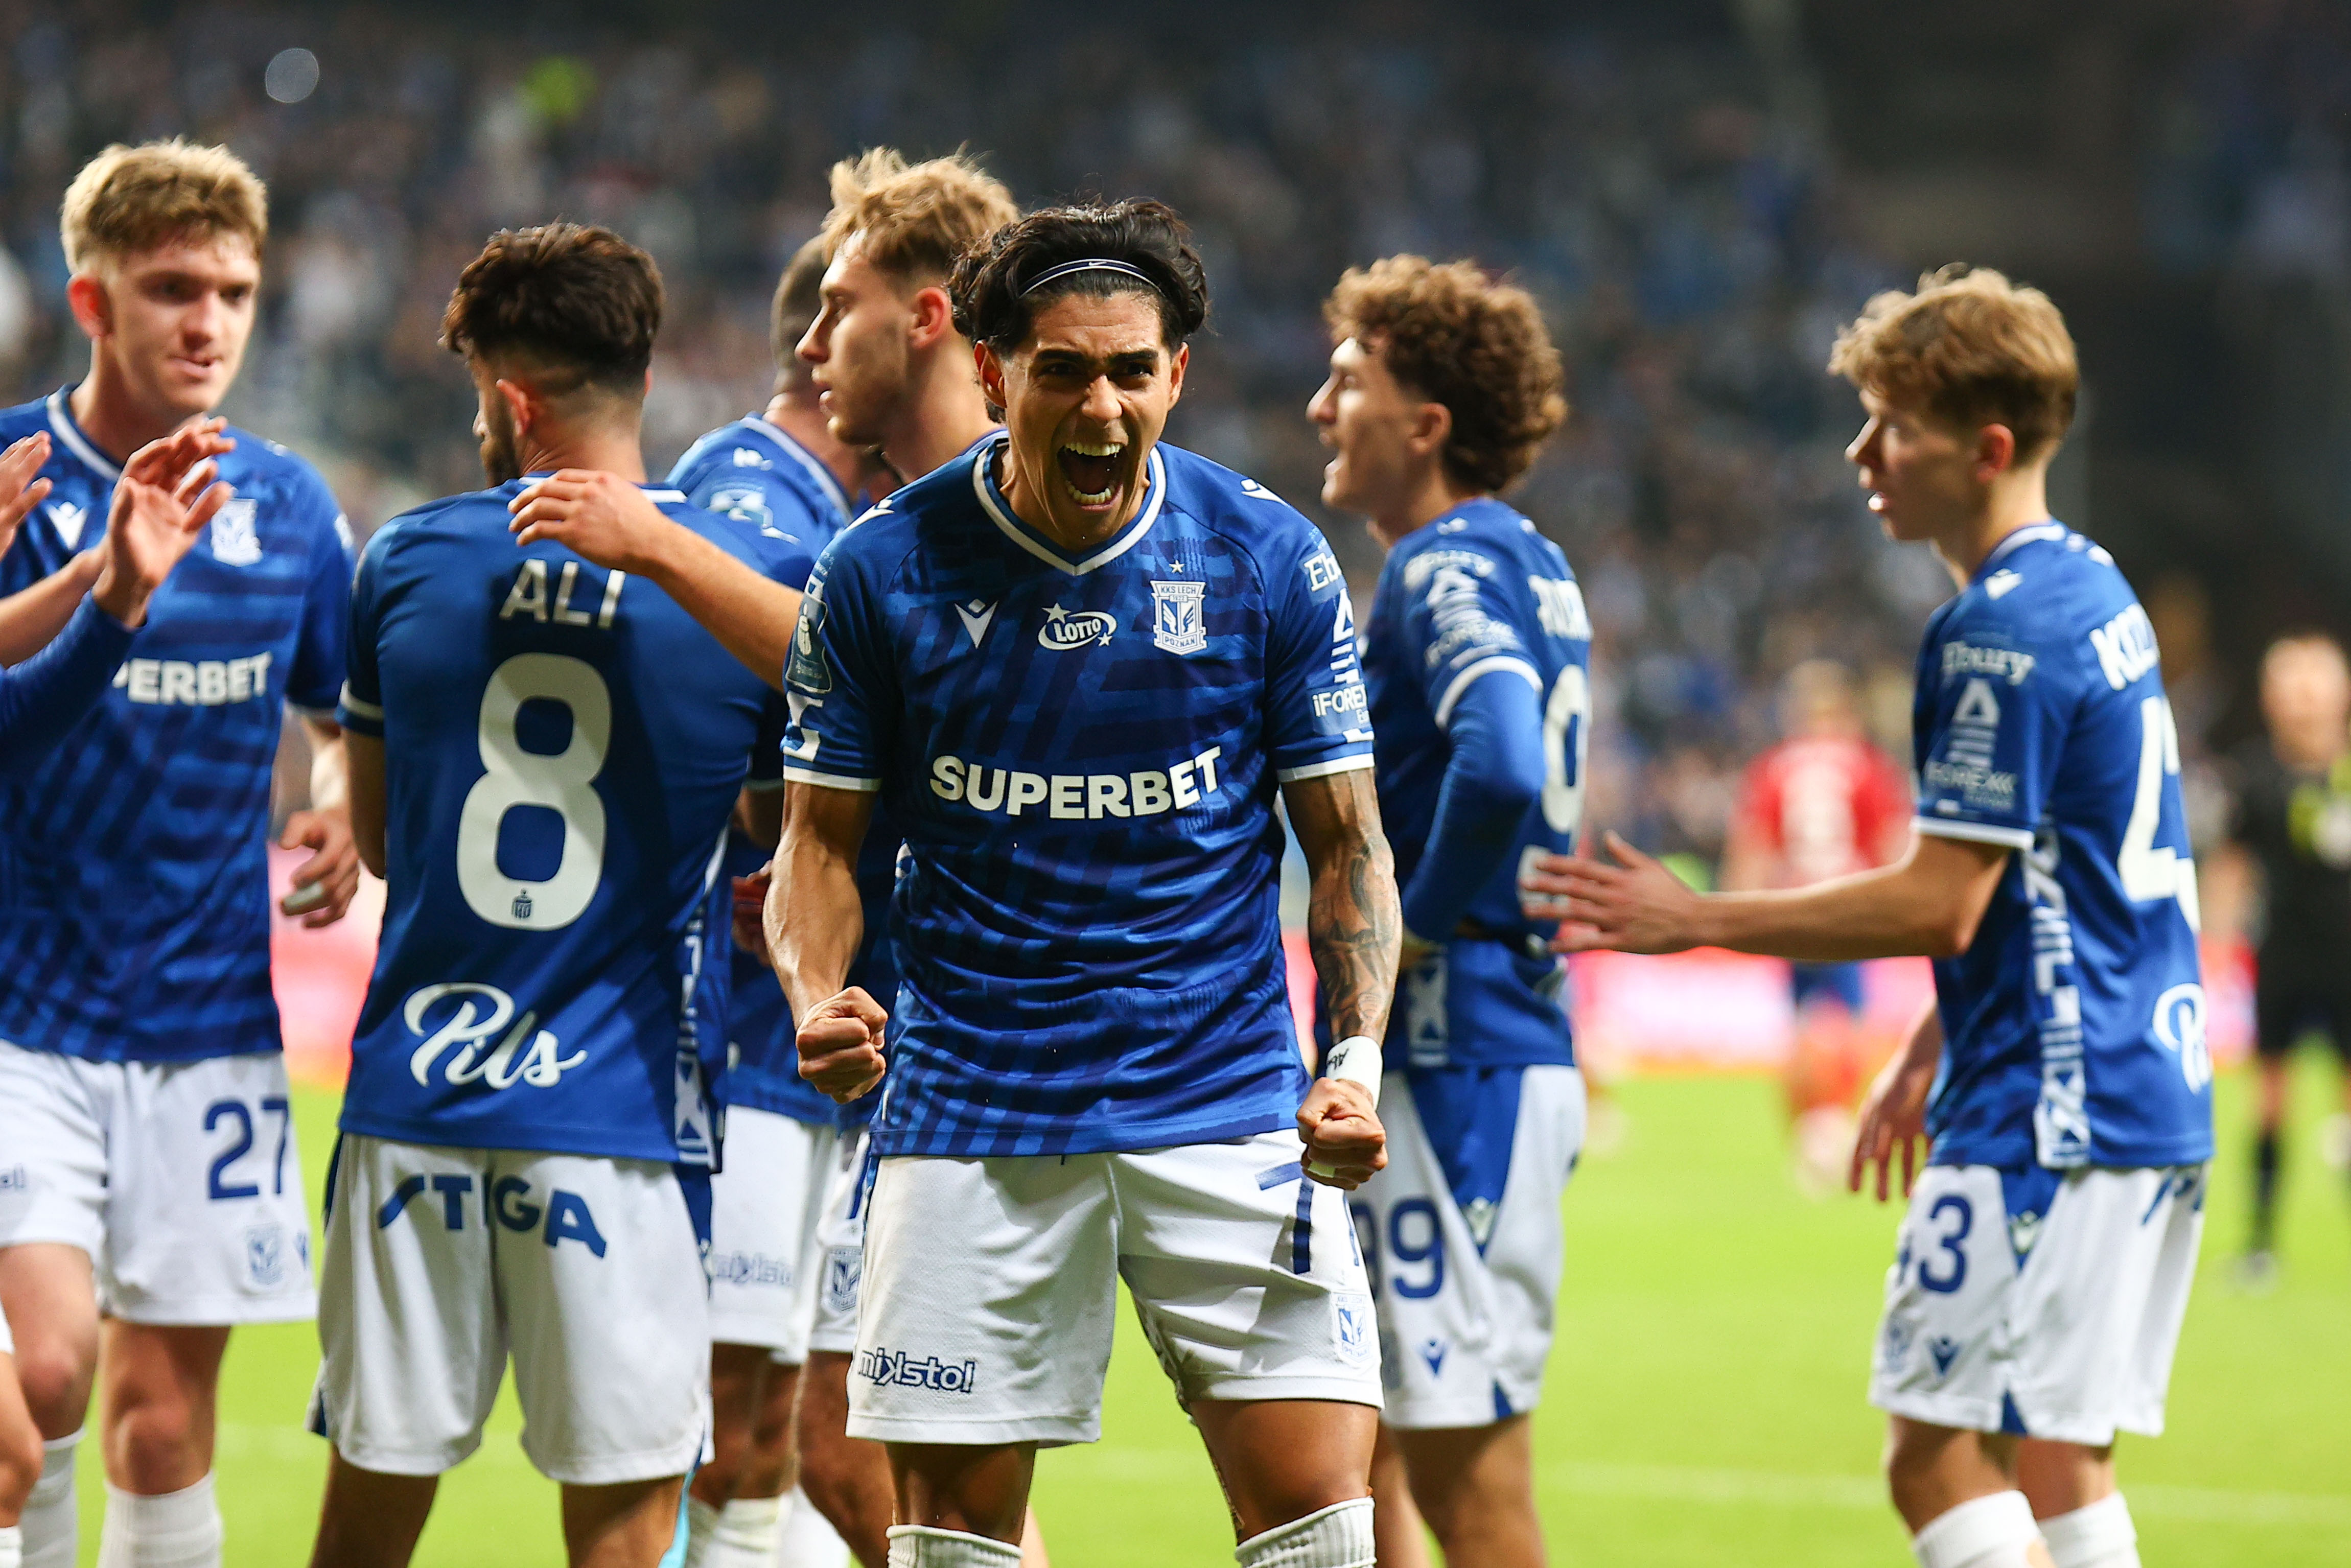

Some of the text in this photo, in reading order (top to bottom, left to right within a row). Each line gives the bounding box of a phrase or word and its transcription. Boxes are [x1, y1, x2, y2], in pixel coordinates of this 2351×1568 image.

[499, 559, 625, 630] ALI
[1053, 618, 1102, 642] LOTTO
[1178, 586, 1196, 594] LECH
[456, 651, 612, 931] 8
[929, 744, 1221, 820] SUPERBET
[404, 981, 588, 1090] Pils
[205, 1098, 289, 1199] 27
[378, 1174, 607, 1258] TGA
[1897, 1193, 1971, 1294] 3
